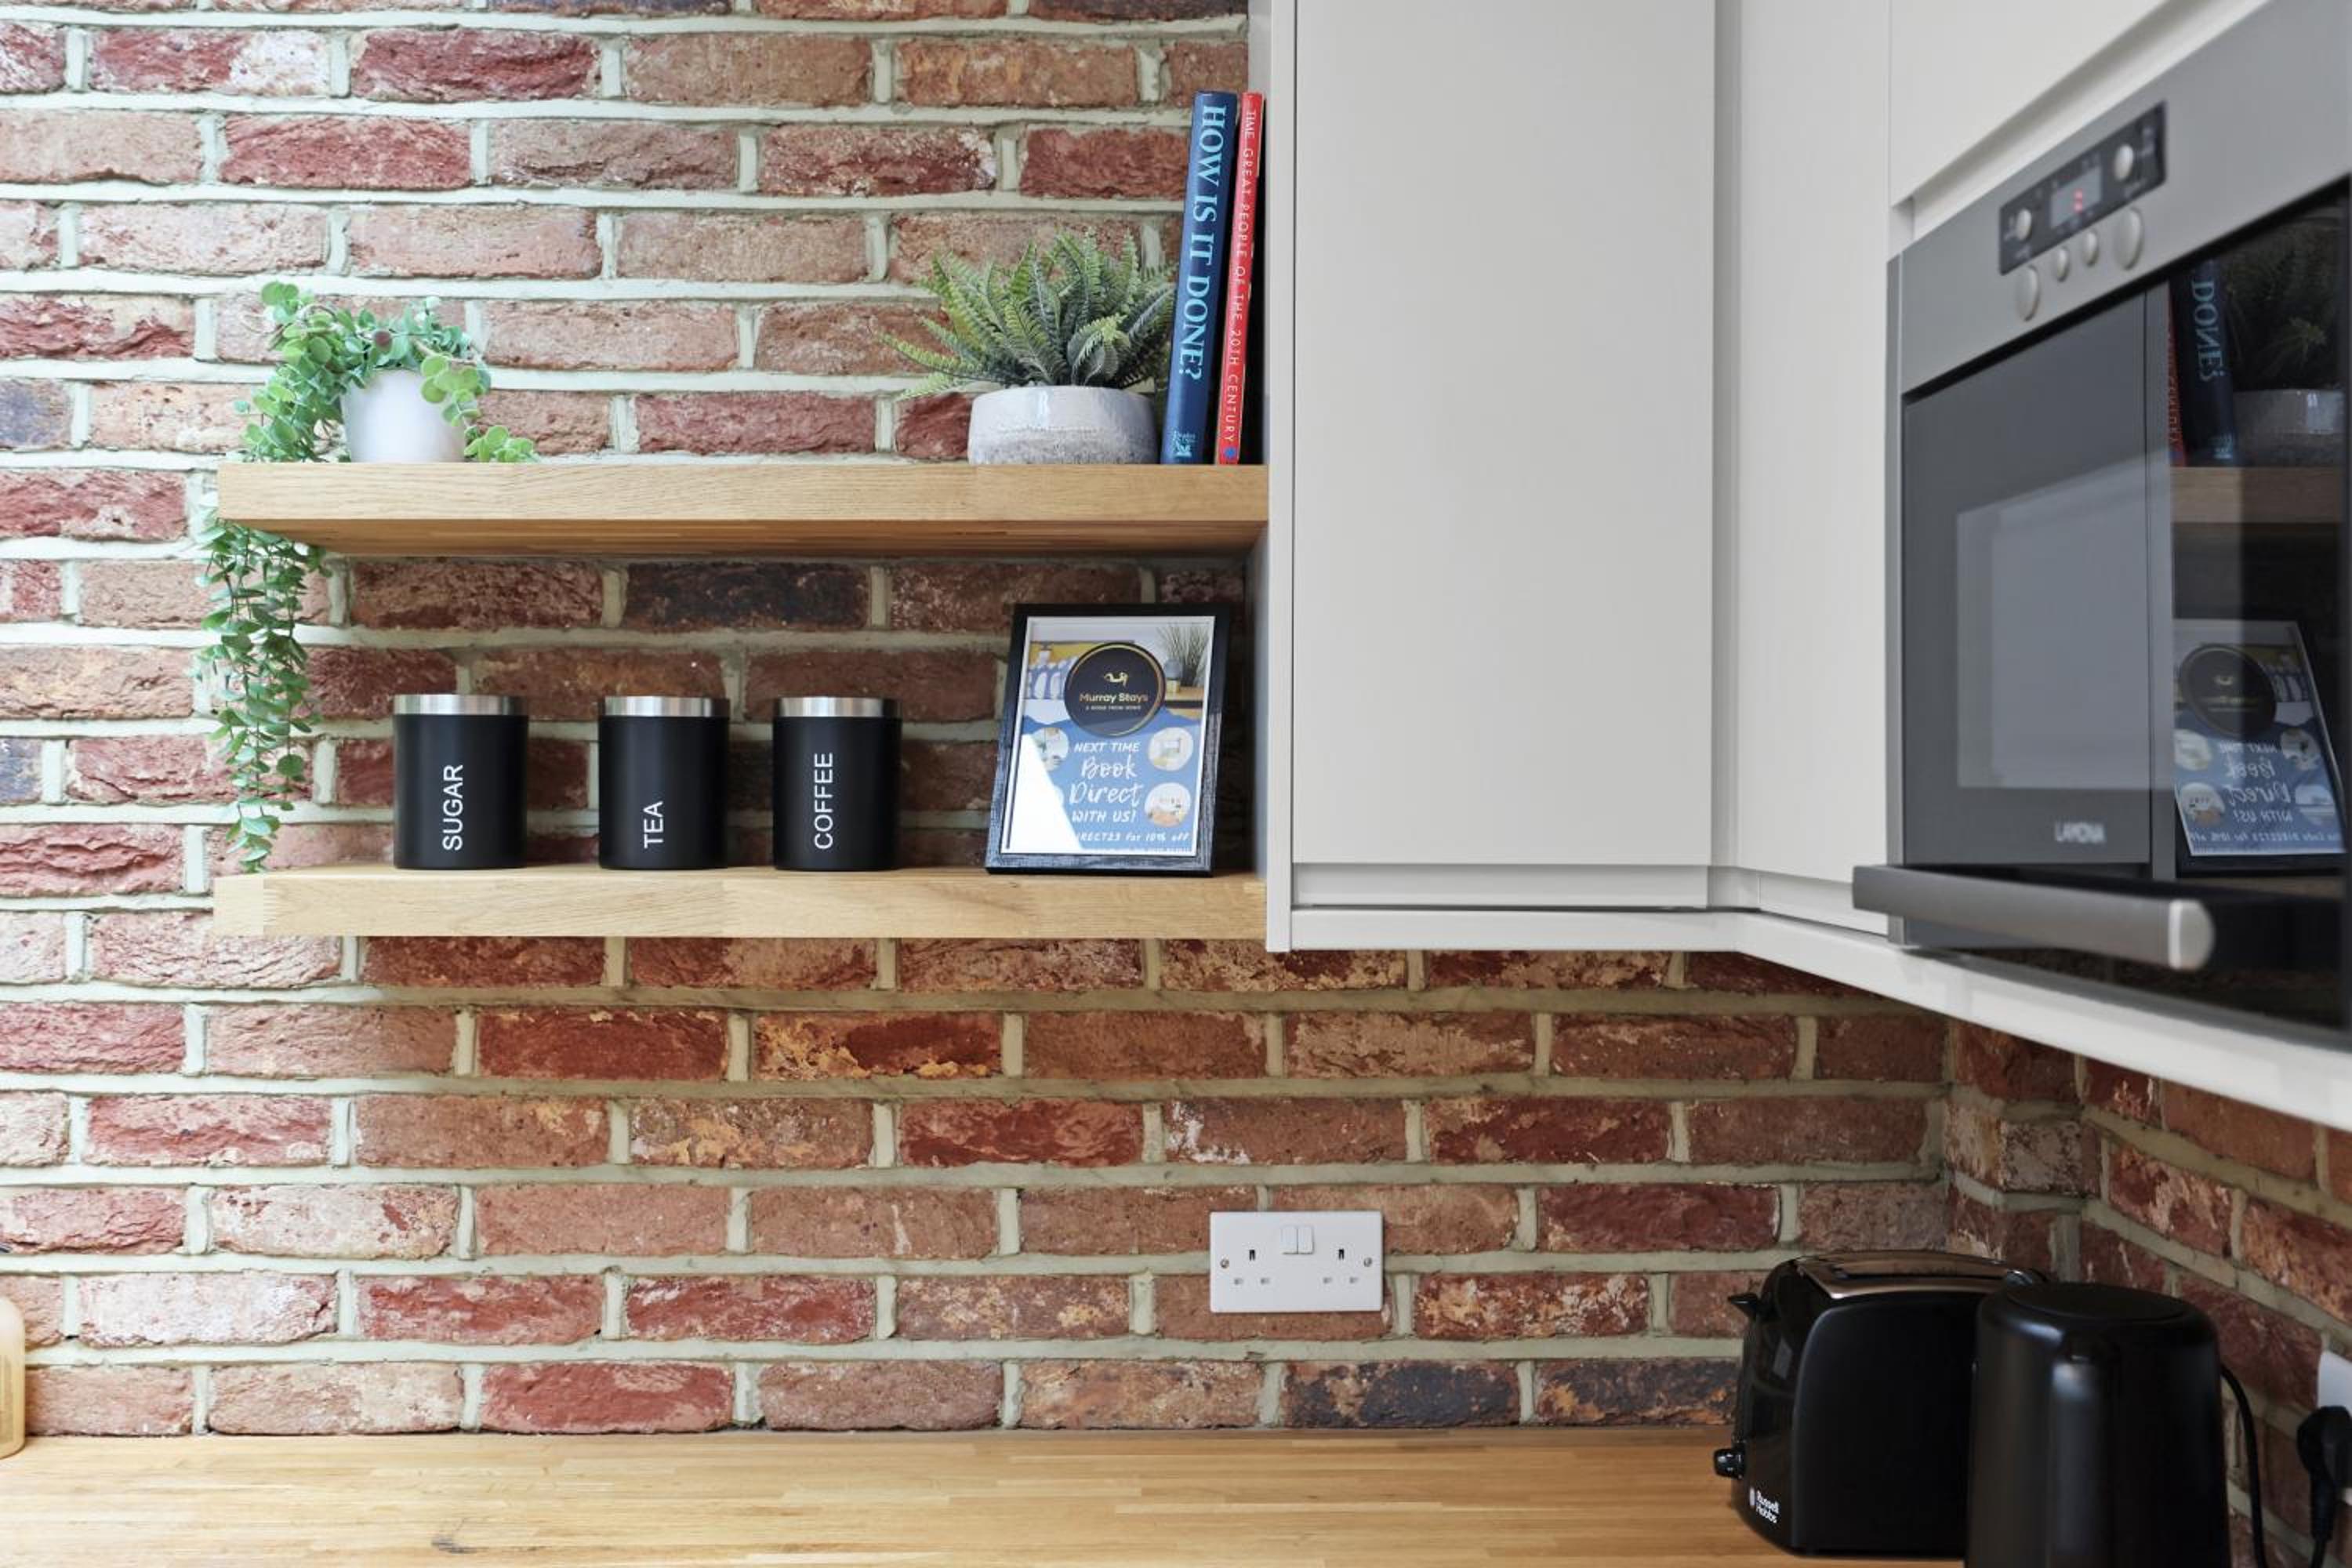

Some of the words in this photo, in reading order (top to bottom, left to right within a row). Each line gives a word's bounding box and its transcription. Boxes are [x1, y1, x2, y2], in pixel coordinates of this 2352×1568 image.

[1244, 111, 1256, 139] TIME
[1198, 105, 1226, 187] HOW
[1241, 150, 1254, 195] GREAT
[1192, 196, 1218, 222] IS
[1236, 203, 1250, 257] PEOPLE
[1189, 233, 1214, 265] IT
[1234, 266, 1246, 286] OF
[1231, 294, 1243, 320] THE
[1178, 275, 1210, 380] DONE?
[1229, 330, 1241, 365] 20TH
[1224, 376, 1238, 442] CENTURY
[1079, 693, 1116, 703] Murray
[1119, 692, 1149, 702] Stays
[1074, 742, 1107, 753] NEXT
[1112, 742, 1142, 753] TIME
[1080, 753, 1137, 779] Book
[442, 764, 463, 851] SUGAR
[815, 752, 833, 850] COFFEE
[1069, 782, 1144, 808] Direct
[644, 800, 663, 848] TEA
[1072, 810, 1107, 822] WITH
[1112, 810, 1137, 822] US!
